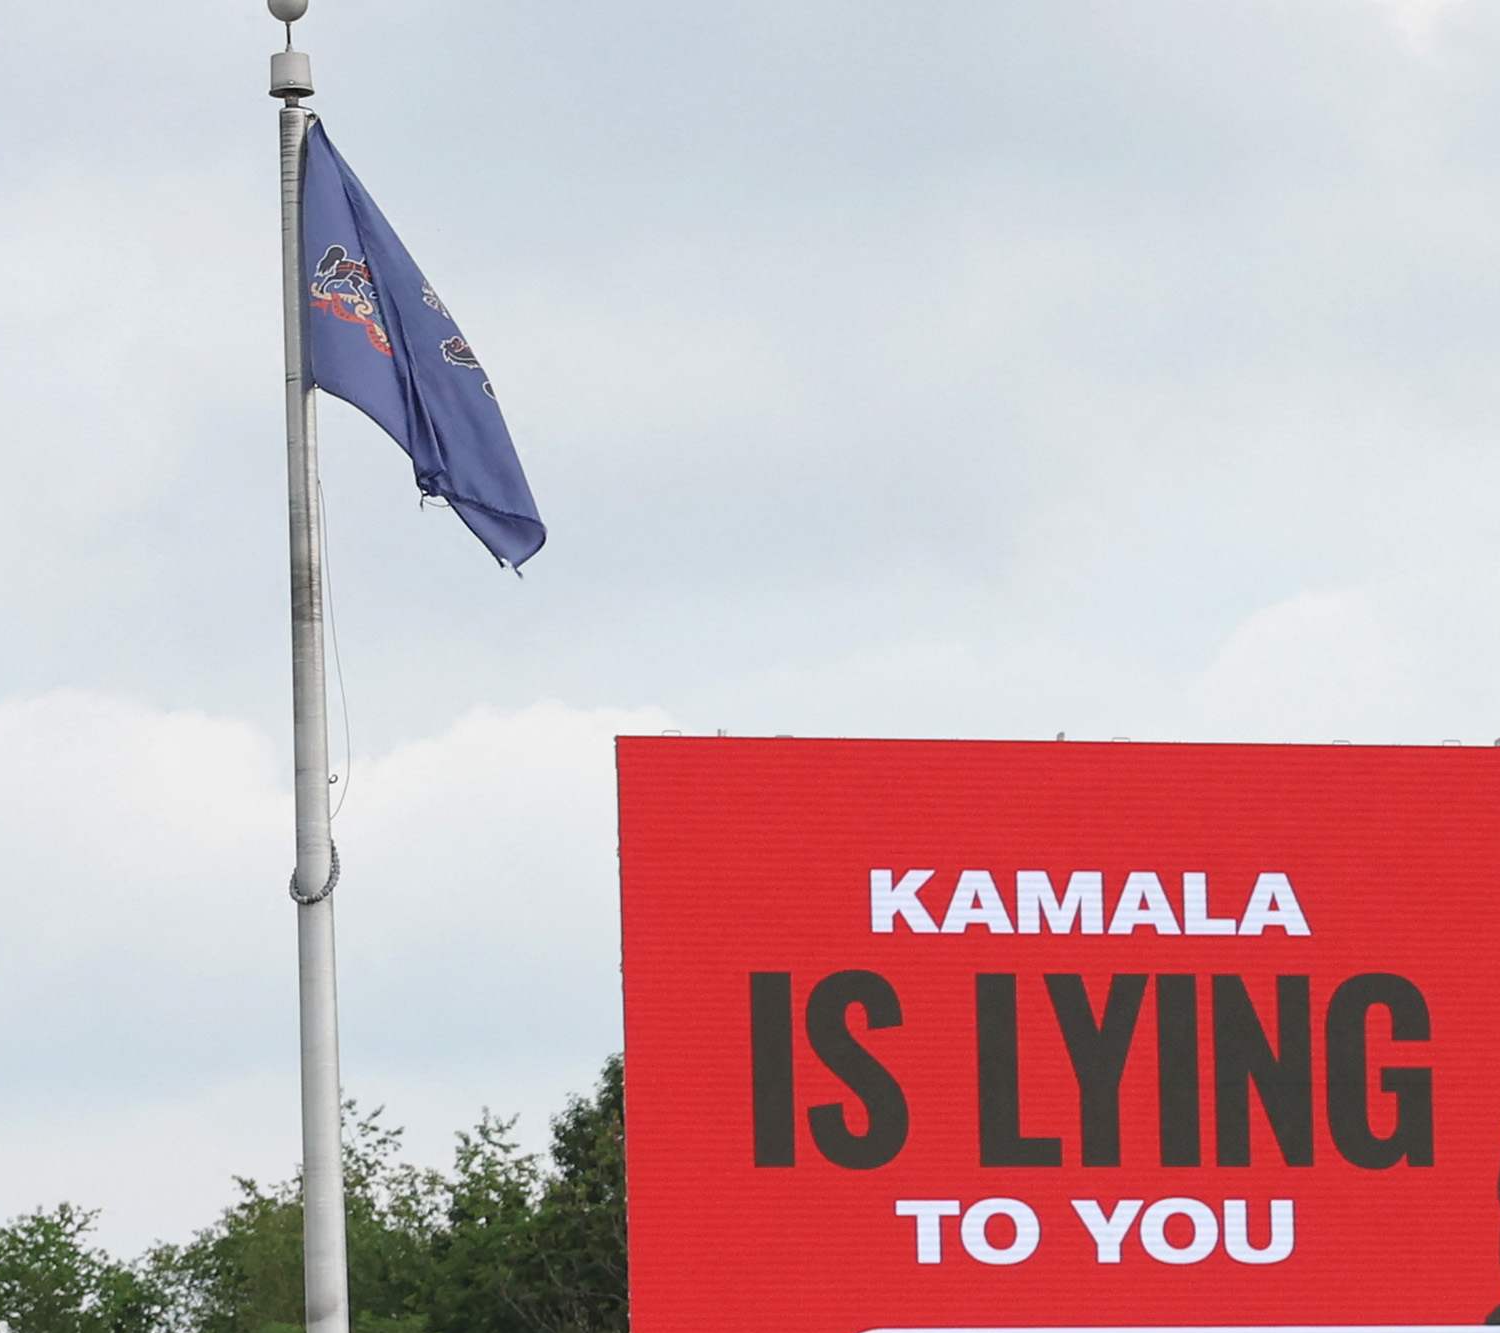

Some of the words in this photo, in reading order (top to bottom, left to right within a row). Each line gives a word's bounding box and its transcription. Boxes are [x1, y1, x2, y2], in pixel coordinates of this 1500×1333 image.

[869, 869, 1310, 937] KAMALA
[750, 970, 908, 1171] IS
[975, 972, 1435, 1170] LYING
[895, 1200, 1039, 1266] TO
[1062, 1199, 1296, 1265] YOU
